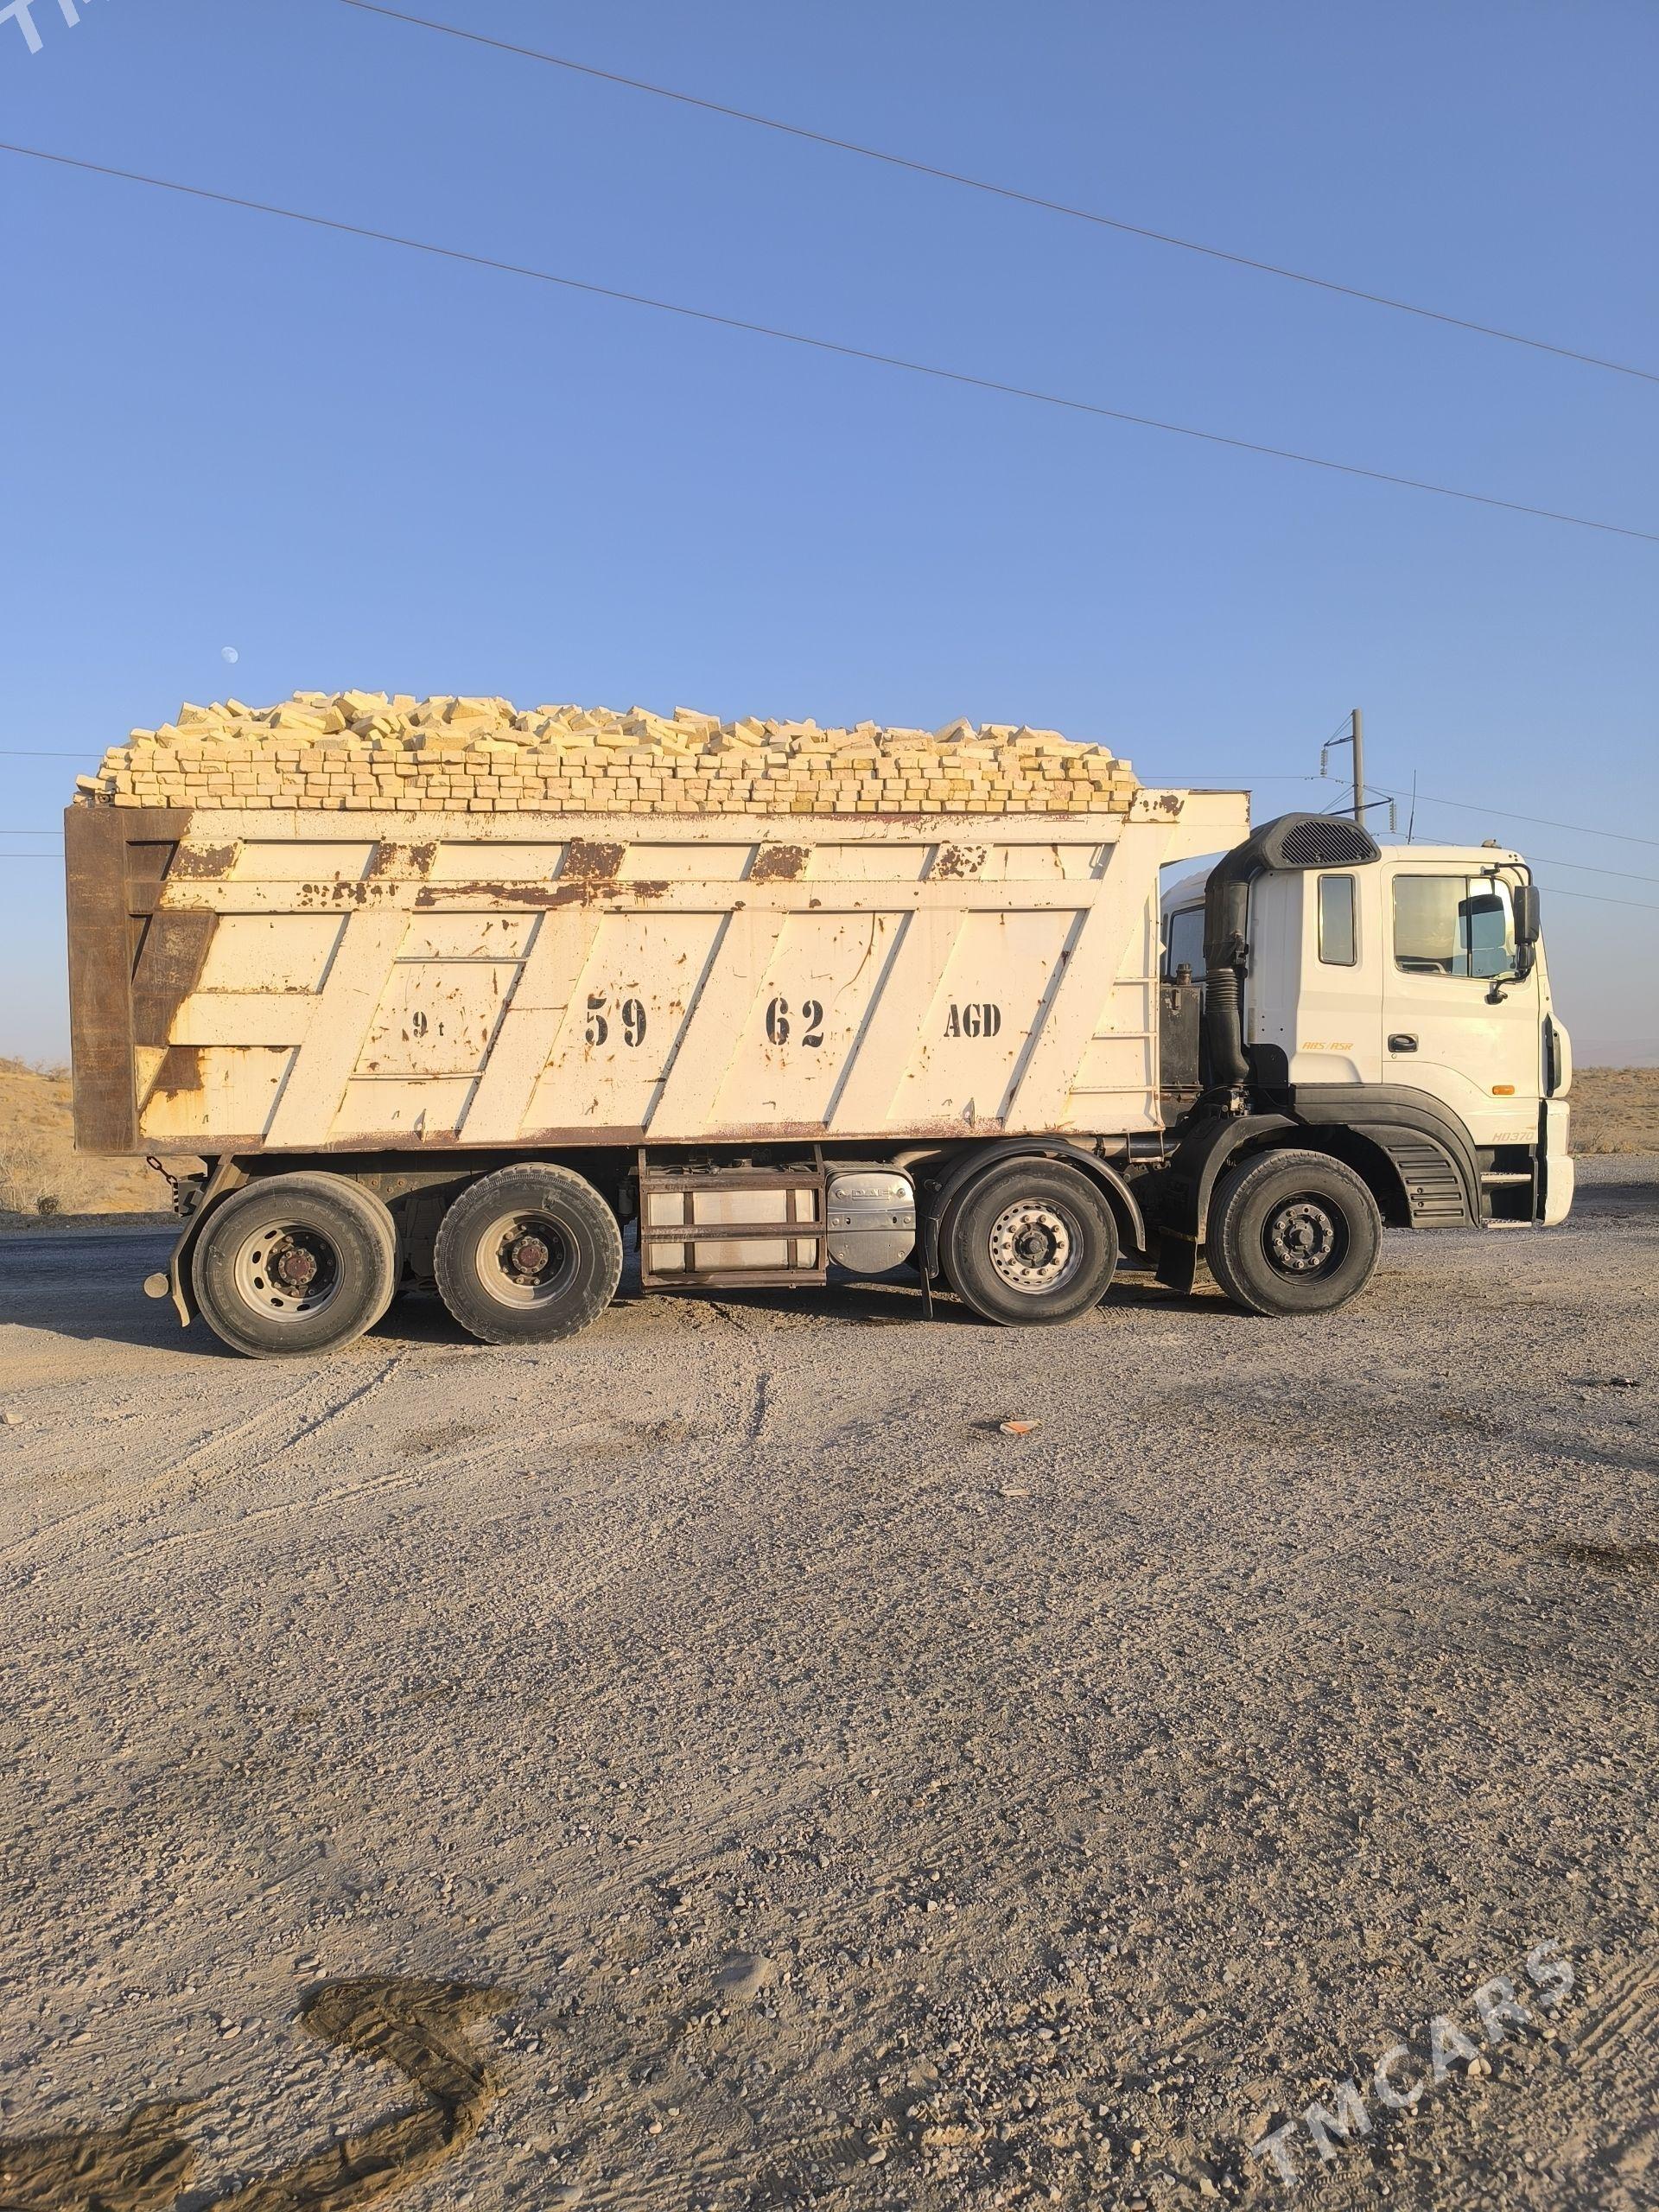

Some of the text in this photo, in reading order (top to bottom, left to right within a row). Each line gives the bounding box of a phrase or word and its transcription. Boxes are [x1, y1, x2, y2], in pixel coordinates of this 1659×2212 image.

[413, 1011, 427, 1038] 9
[585, 997, 647, 1047] 59
[766, 997, 824, 1047] 62
[944, 1003, 1001, 1038] AGD
[1493, 1132, 1535, 1141] HD370
